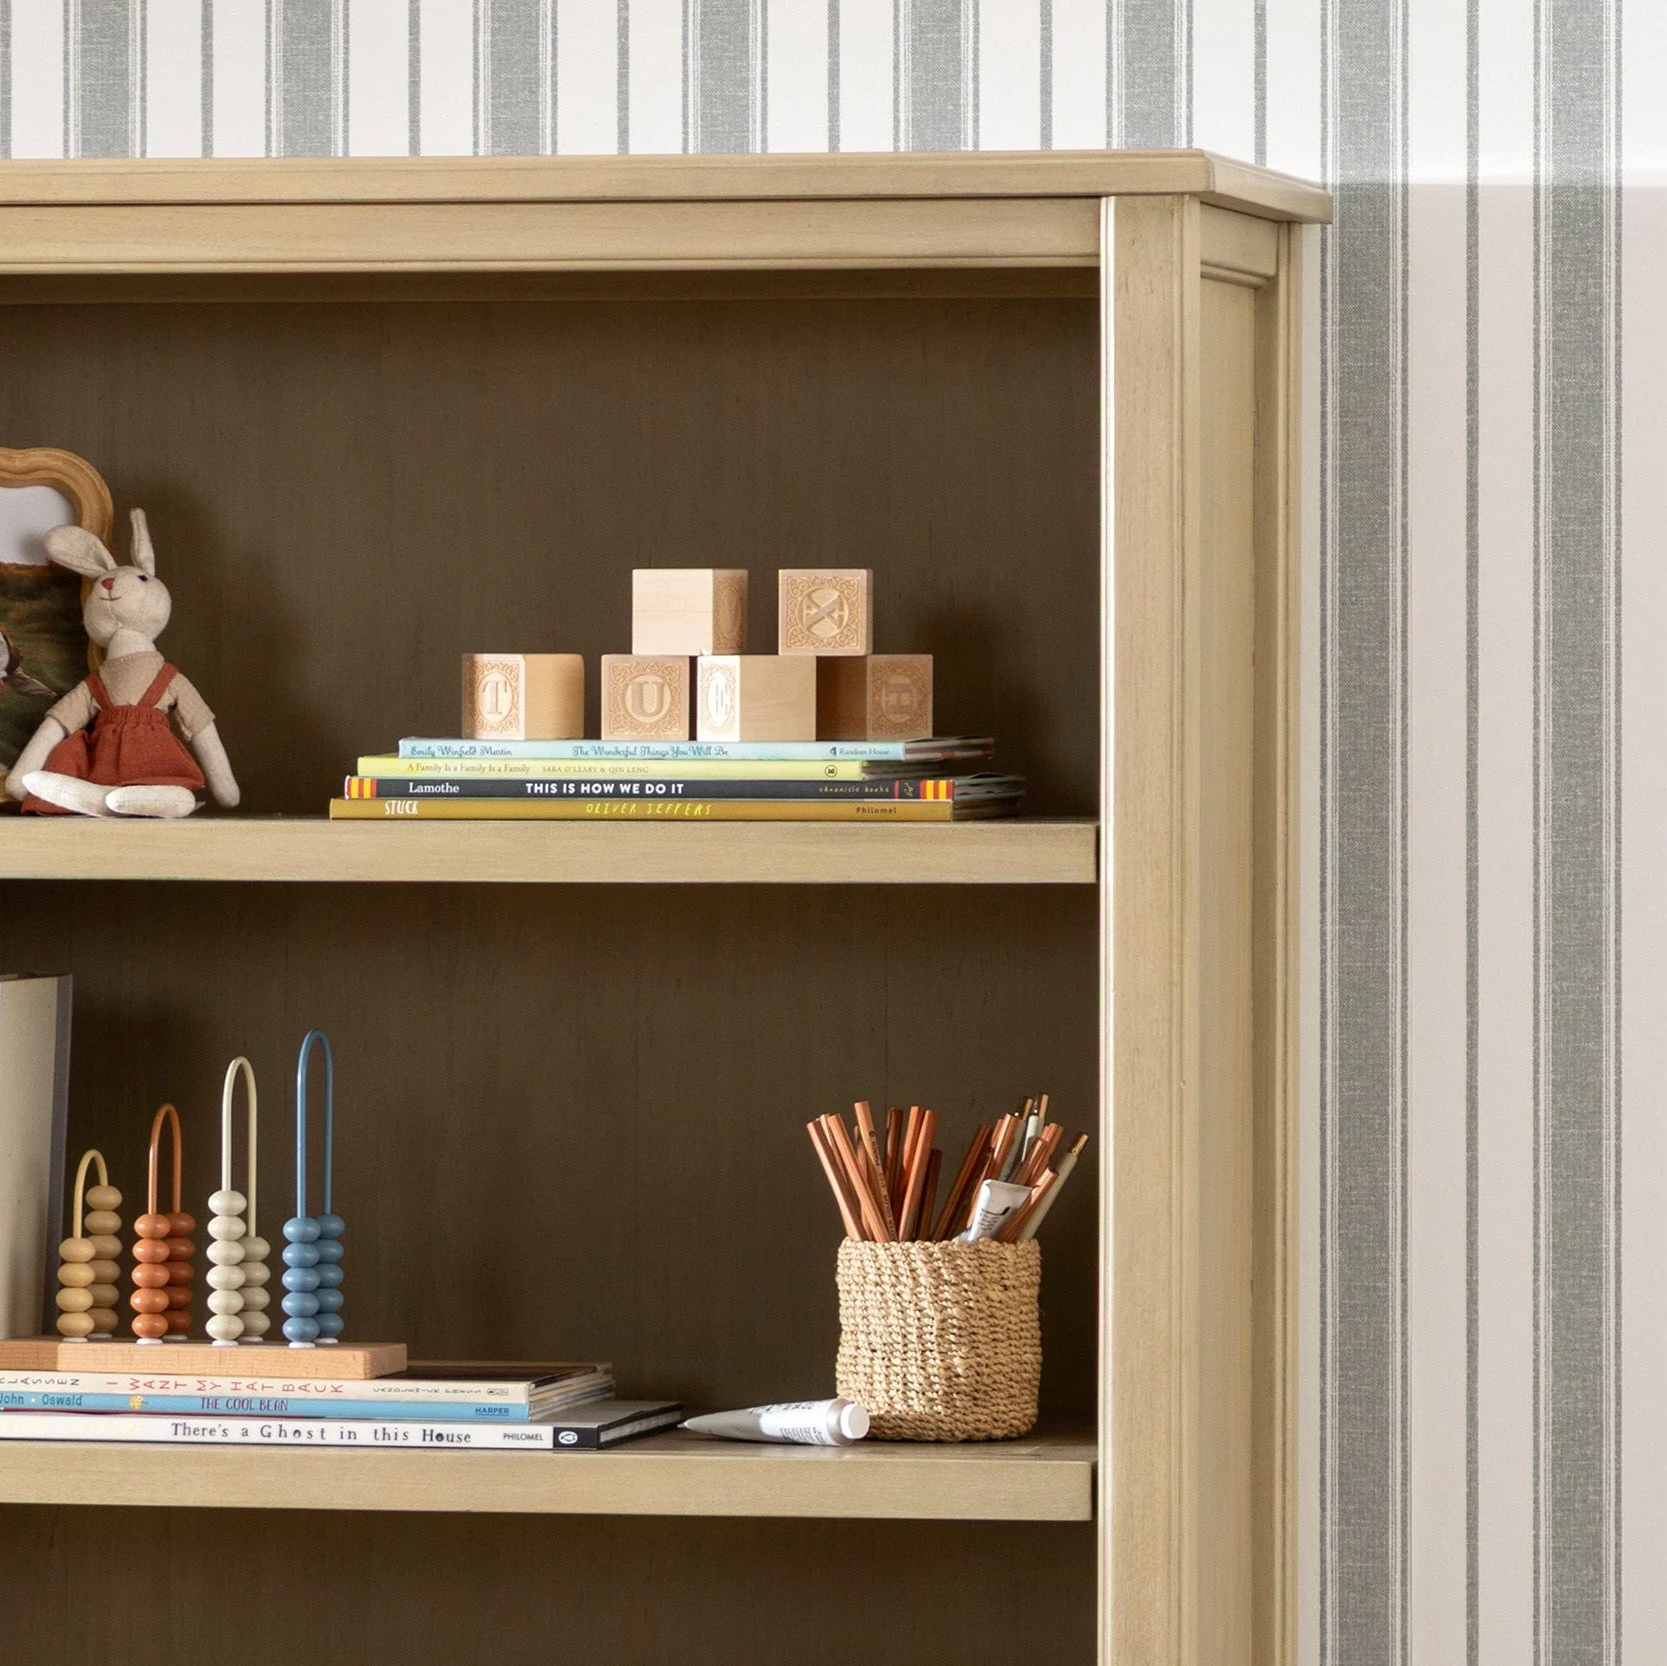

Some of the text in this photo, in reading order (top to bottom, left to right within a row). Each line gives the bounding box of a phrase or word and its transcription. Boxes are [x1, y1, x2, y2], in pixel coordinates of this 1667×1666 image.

[482, 679, 507, 715] T
[630, 681, 665, 717] U
[410, 746, 512, 757] Emily Winfield Martin
[572, 746, 728, 758] The Wonderful Things You Will Be
[416, 764, 442, 774] Family
[445, 764, 452, 772] Is
[460, 764, 485, 774] Family
[489, 764, 496, 772] Is
[504, 764, 531, 774] Family
[409, 782, 460, 793] Lamothe
[526, 783, 684, 794] THIS IS HOW WE DO IT
[385, 800, 419, 815] STUCK
[586, 803, 712, 816] OLIVER JEFFERS
[856, 806, 897, 814] Philomel
[129, 1378, 187, 1390] WANT
[197, 1379, 221, 1392] MY
[231, 1381, 274, 1392] HAT
[282, 1383, 344, 1394] BACK
[41, 1394, 82, 1406] Oswald
[201, 1397, 289, 1411] THE COOL BEAN
[475, 1407, 510, 1415] HARPER
[171, 1422, 472, 1443] There's a Ghost in this House
[503, 1432, 543, 1442] PHILOMEL
